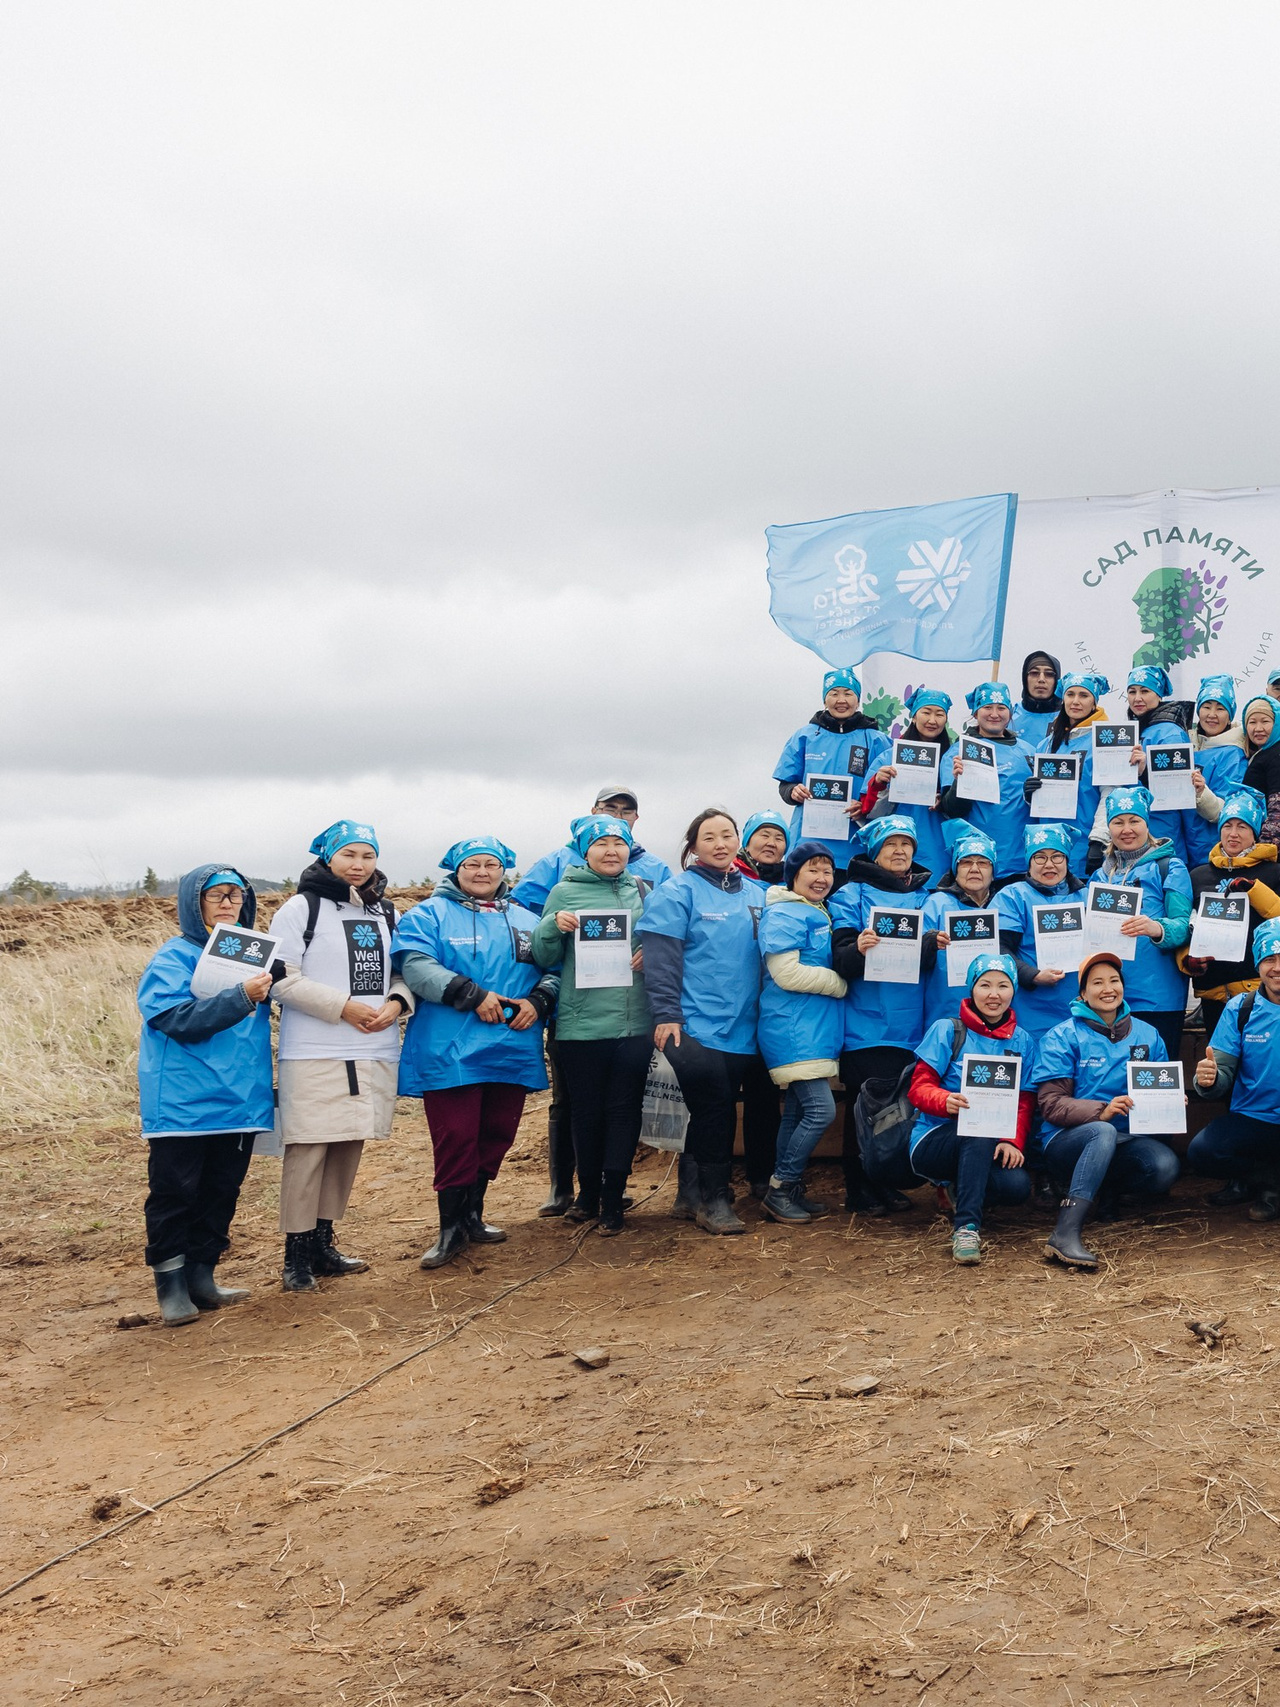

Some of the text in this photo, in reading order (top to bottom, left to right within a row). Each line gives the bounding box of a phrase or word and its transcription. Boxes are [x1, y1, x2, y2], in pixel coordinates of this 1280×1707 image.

[1082, 526, 1265, 588] САД ПАМЯТИ
[1234, 632, 1273, 688] АКЦИЯ
[354, 950, 380, 961] Well
[355, 962, 381, 971] ness
[354, 970, 382, 980] Gene
[353, 980, 383, 990] ration
[646, 1079, 682, 1093] BERIAN
[644, 1090, 685, 1103] ELLNESS
